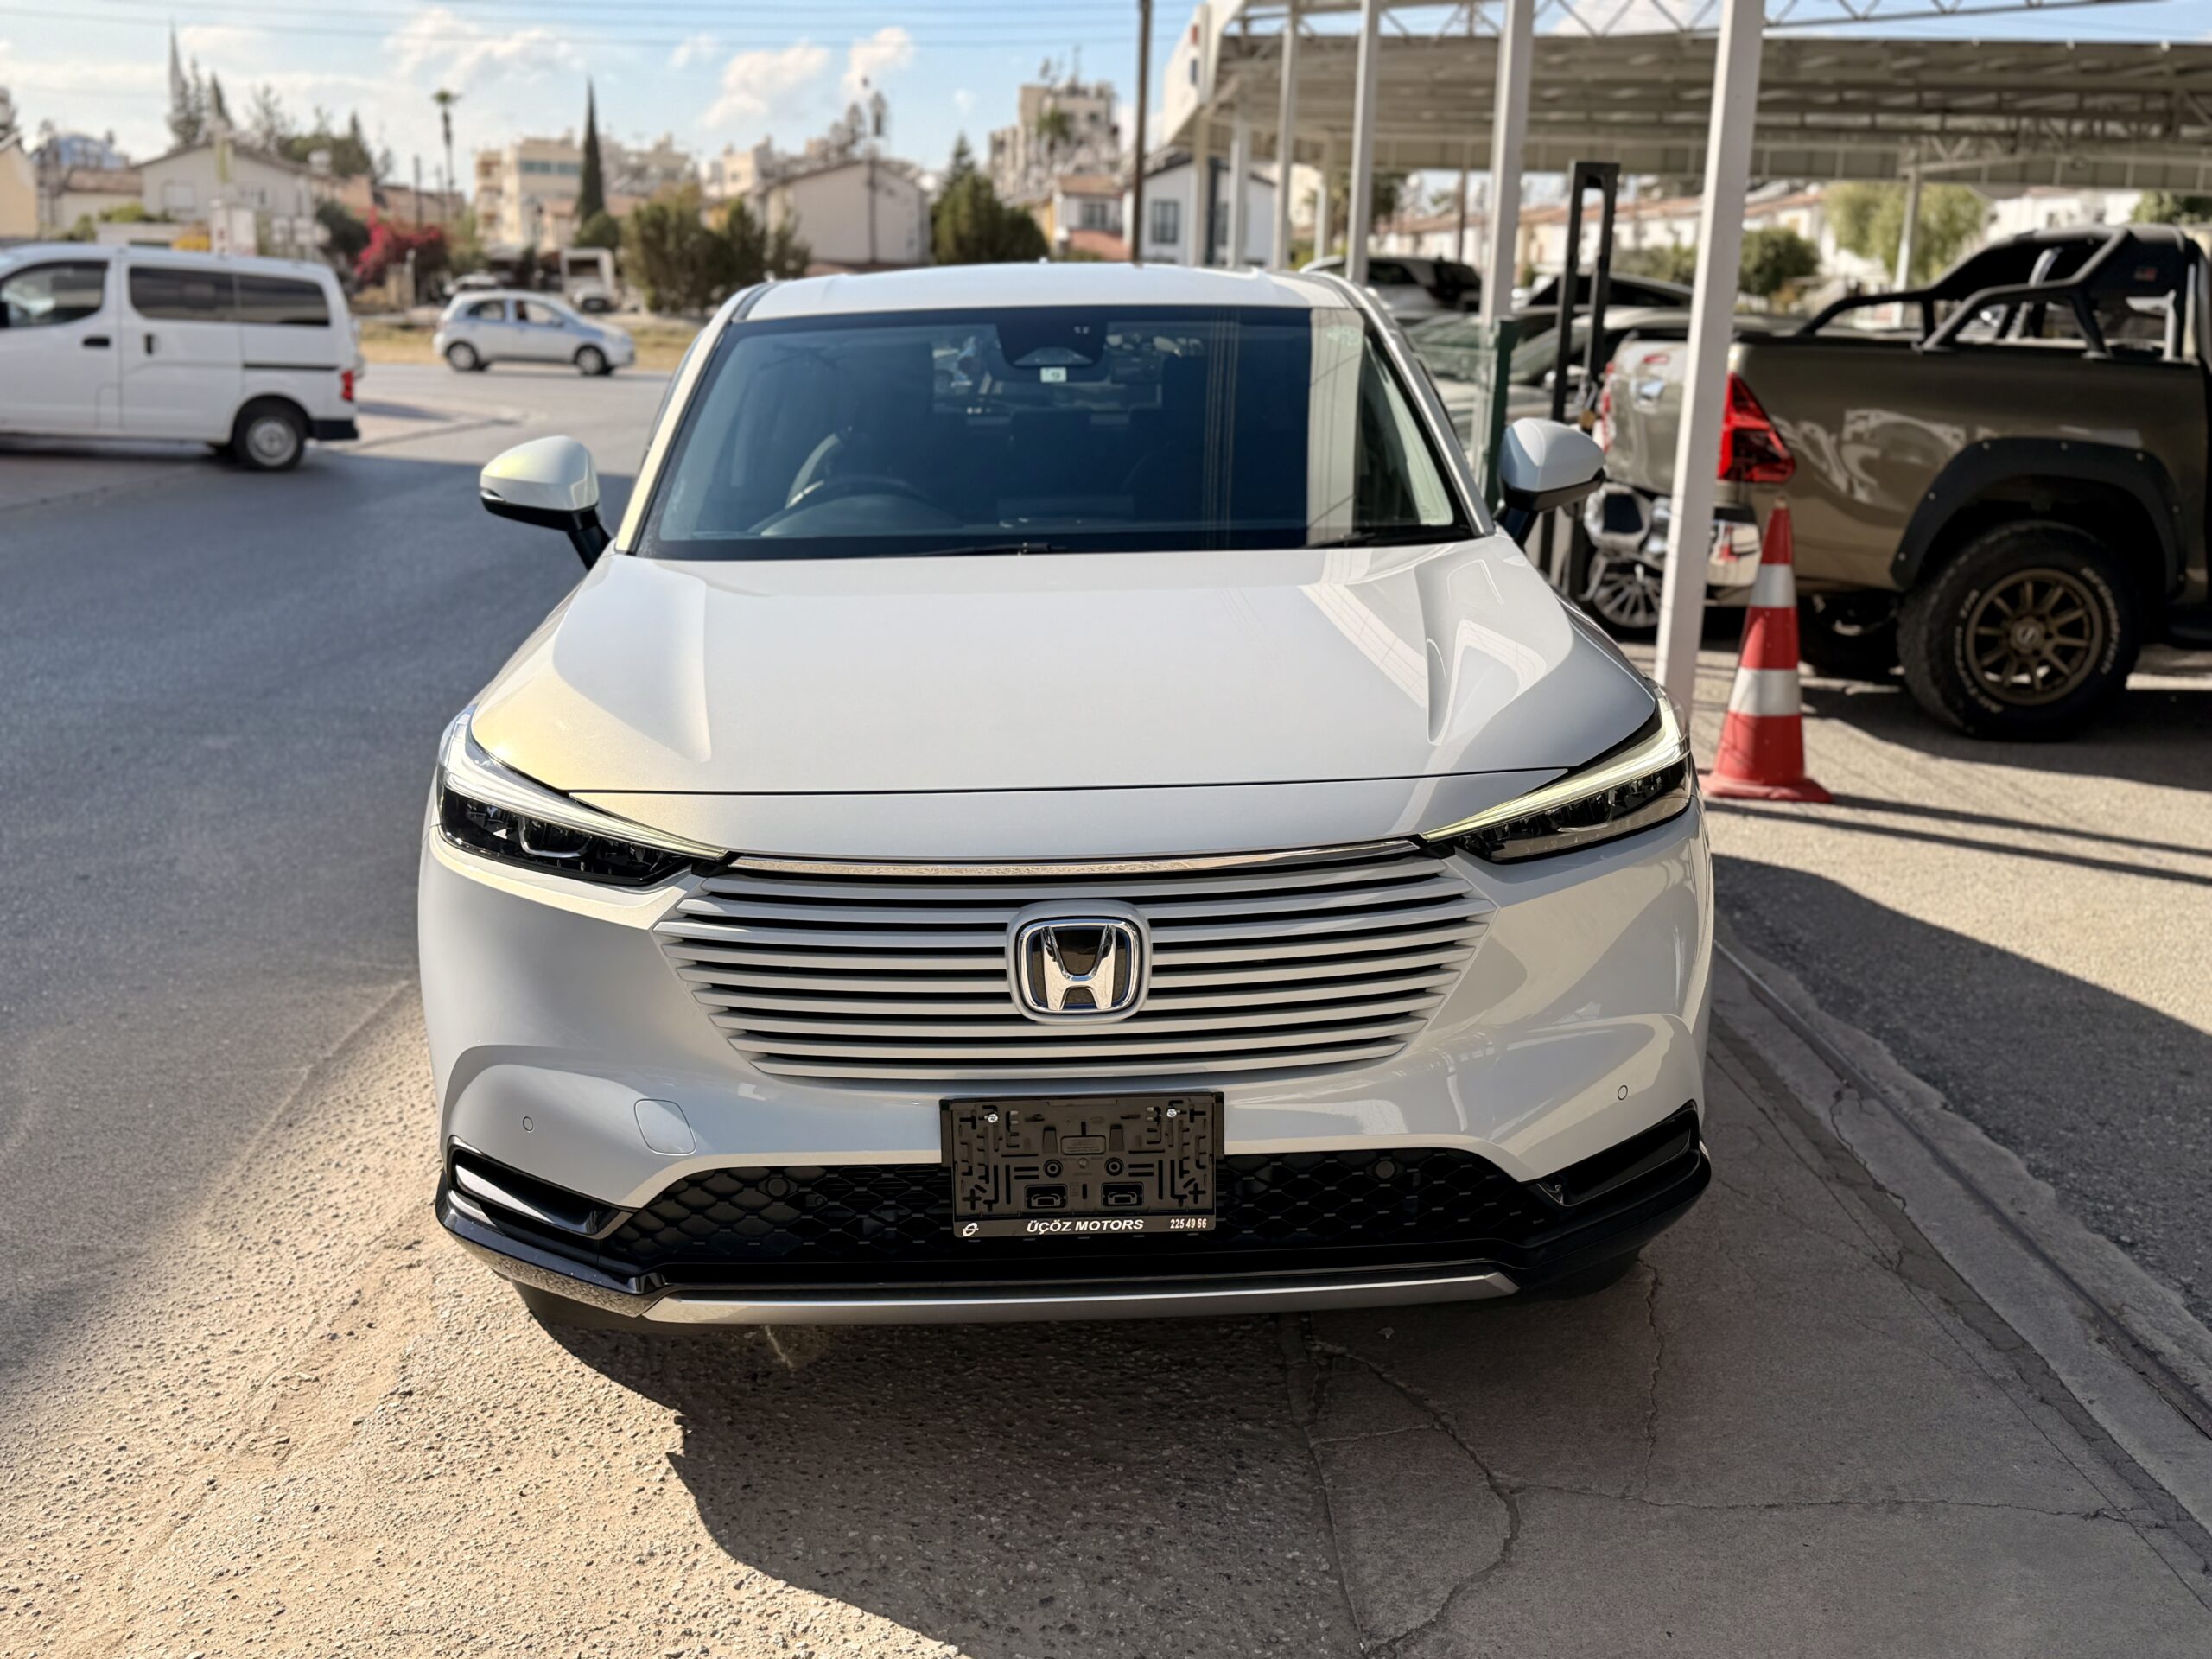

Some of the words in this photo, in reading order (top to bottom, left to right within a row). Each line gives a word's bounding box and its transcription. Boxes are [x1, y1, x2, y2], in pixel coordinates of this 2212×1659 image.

[1027, 1219, 1071, 1235] ÜÇÖZ
[1075, 1219, 1144, 1230] MOTORS
[1170, 1219, 1185, 1229] 225
[1186, 1218, 1195, 1228] 49
[1198, 1218, 1206, 1228] 66
